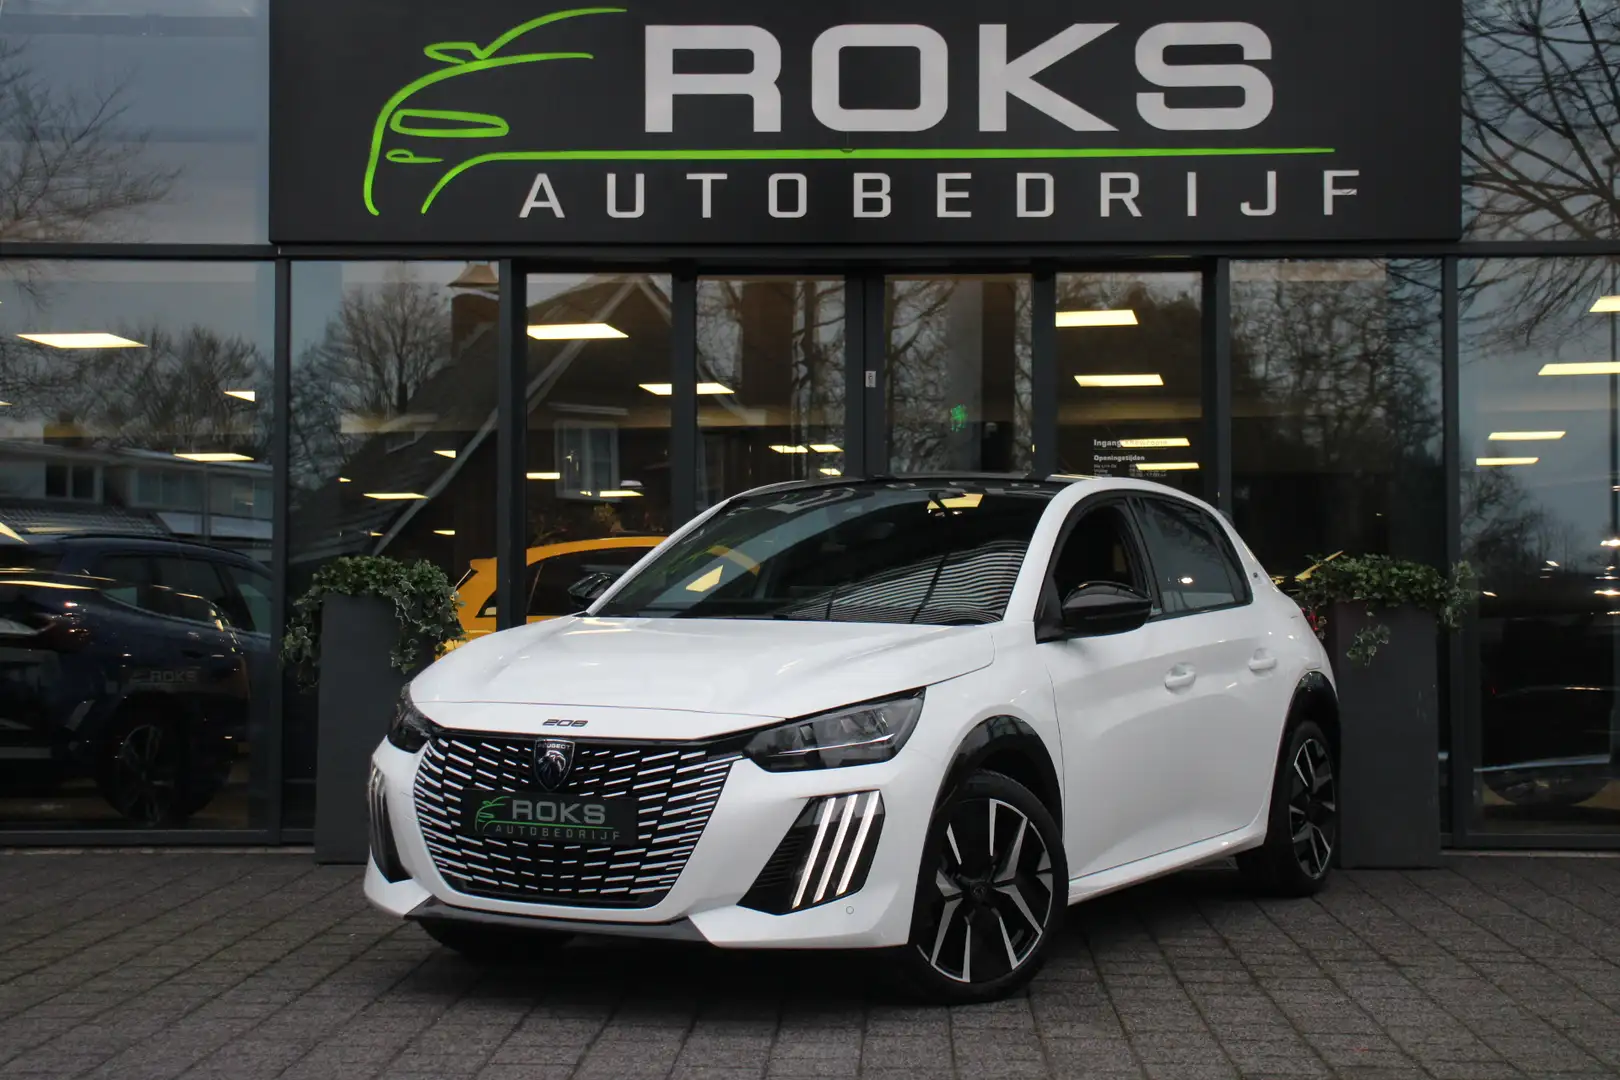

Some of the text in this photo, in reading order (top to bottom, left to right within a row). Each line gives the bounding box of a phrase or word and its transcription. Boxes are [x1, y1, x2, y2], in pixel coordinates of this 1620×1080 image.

[644, 22, 1274, 133] ROKS
[519, 170, 1361, 219] AUTOBEDRIJF
[1093, 439, 1122, 448] Ingang
[542, 718, 588, 728] 208
[512, 800, 606, 825] ROKS
[495, 825, 620, 840] AUTOBEDRIJF
